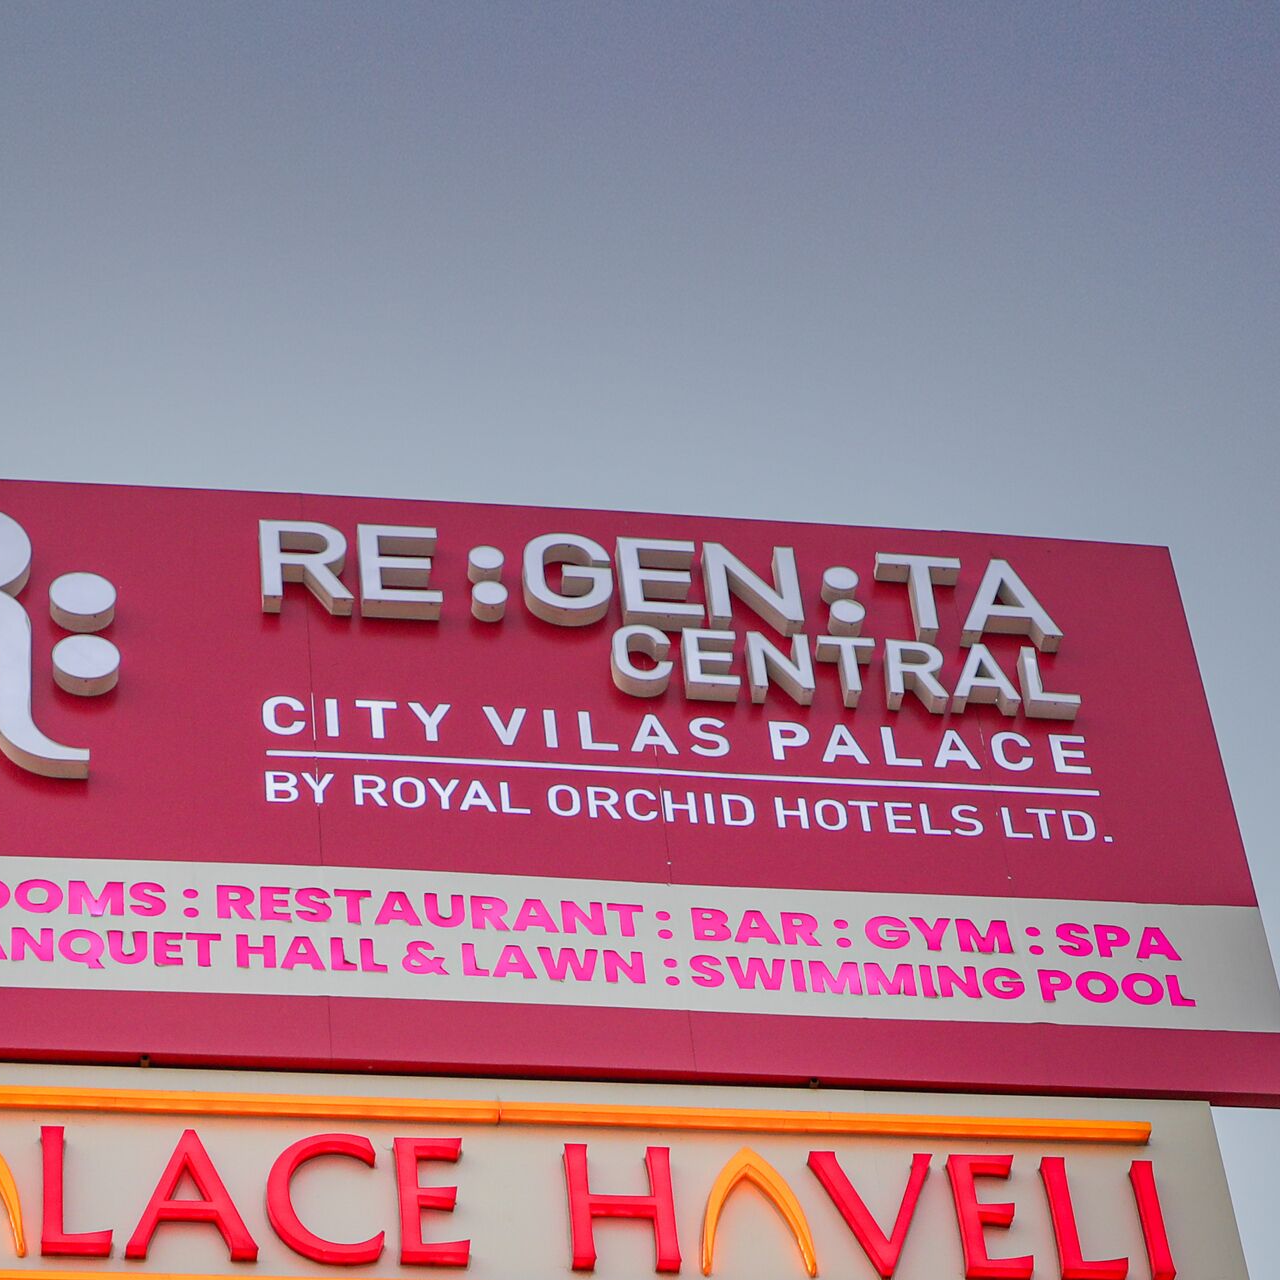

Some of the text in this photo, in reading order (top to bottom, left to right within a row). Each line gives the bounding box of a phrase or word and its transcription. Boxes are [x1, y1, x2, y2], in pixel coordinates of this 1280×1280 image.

[610, 624, 1082, 721] CENTRAL
[261, 695, 1093, 775] CITY VILAS PALACE
[264, 770, 1114, 844] BY ROYAL ORCHID HOTELS LTD.
[216, 884, 645, 939] RESTAURANT
[690, 907, 823, 948] BAR
[864, 914, 1015, 955] GYM
[1056, 921, 1183, 962] SPA
[235, 934, 389, 974] HALL
[401, 940, 450, 976] &
[460, 943, 647, 984] LAWN
[688, 953, 1026, 1000] SWIMMING
[1037, 968, 1197, 1008] POOL
